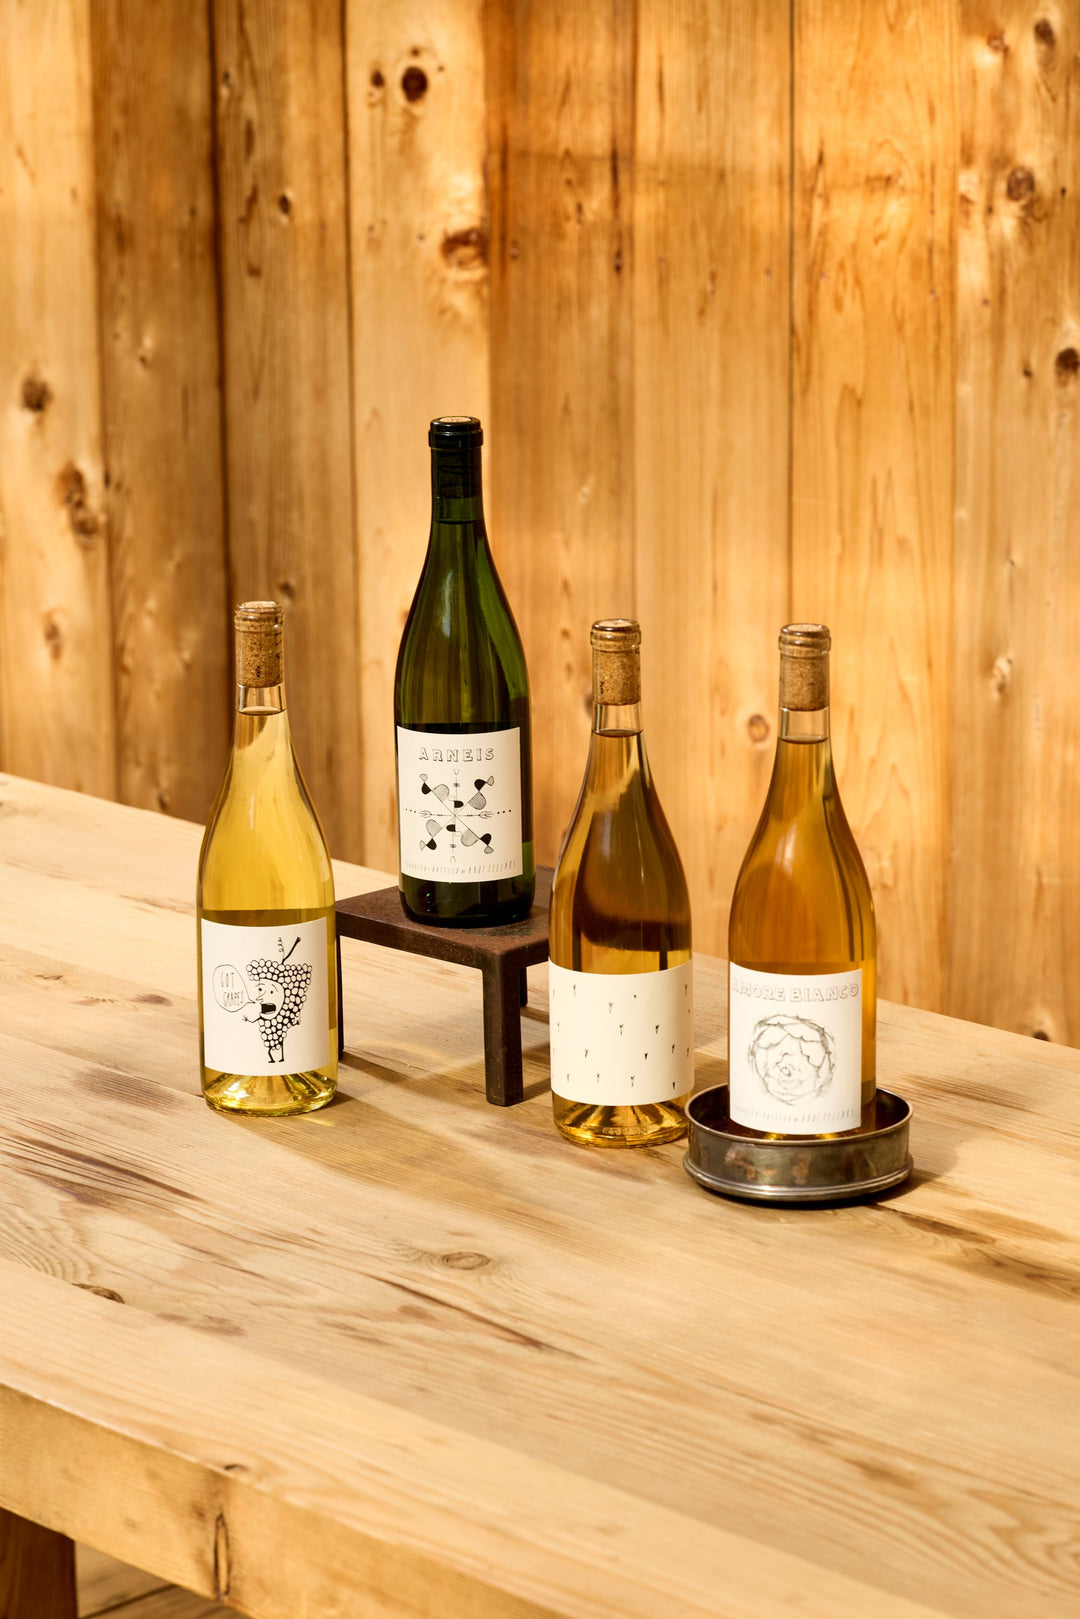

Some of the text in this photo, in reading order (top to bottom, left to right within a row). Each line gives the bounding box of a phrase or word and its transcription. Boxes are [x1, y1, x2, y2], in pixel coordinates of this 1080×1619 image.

[418, 746, 495, 763] ARNEIS
[731, 977, 860, 1003] AMORE BIANCO
